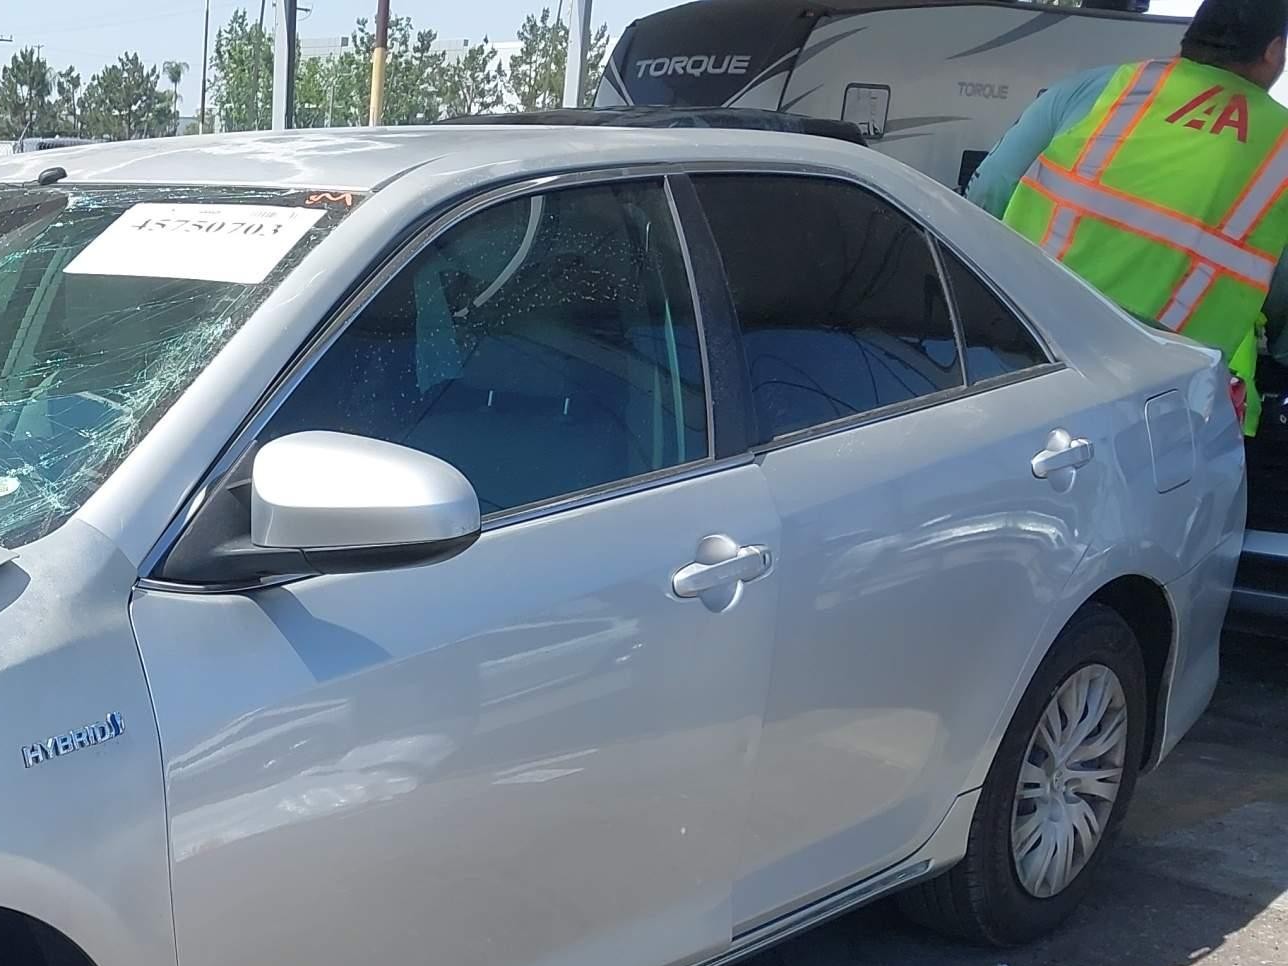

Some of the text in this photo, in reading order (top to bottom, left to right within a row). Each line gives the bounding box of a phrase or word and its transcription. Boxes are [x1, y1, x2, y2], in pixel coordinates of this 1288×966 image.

[636, 55, 752, 79] TORQUE
[958, 82, 1009, 99] TORQUE
[130, 218, 283, 236] 45750703
[21, 719, 114, 769] HYBRID
